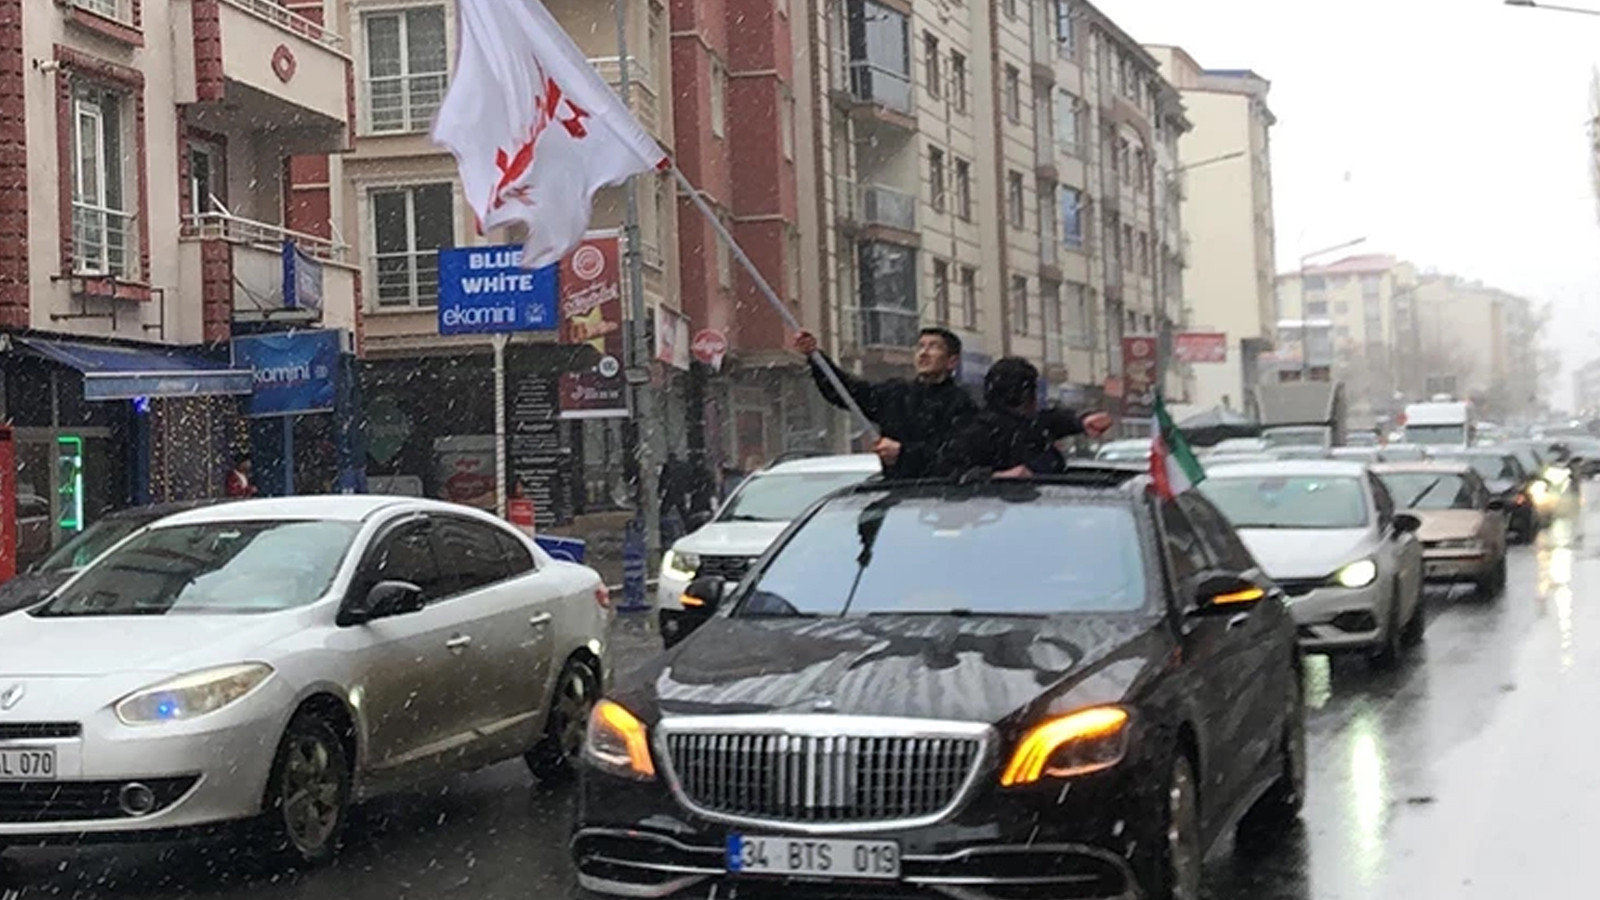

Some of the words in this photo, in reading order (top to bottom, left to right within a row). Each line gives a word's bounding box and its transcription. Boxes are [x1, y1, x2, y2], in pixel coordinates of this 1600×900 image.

[469, 251, 524, 269] BLUE
[443, 301, 516, 326] ekomini
[252, 364, 311, 384] komini
[0, 753, 13, 775] L
[20, 752, 52, 774] 070
[742, 840, 768, 868] 34
[788, 841, 833, 870] BTS
[853, 844, 896, 873] 019
